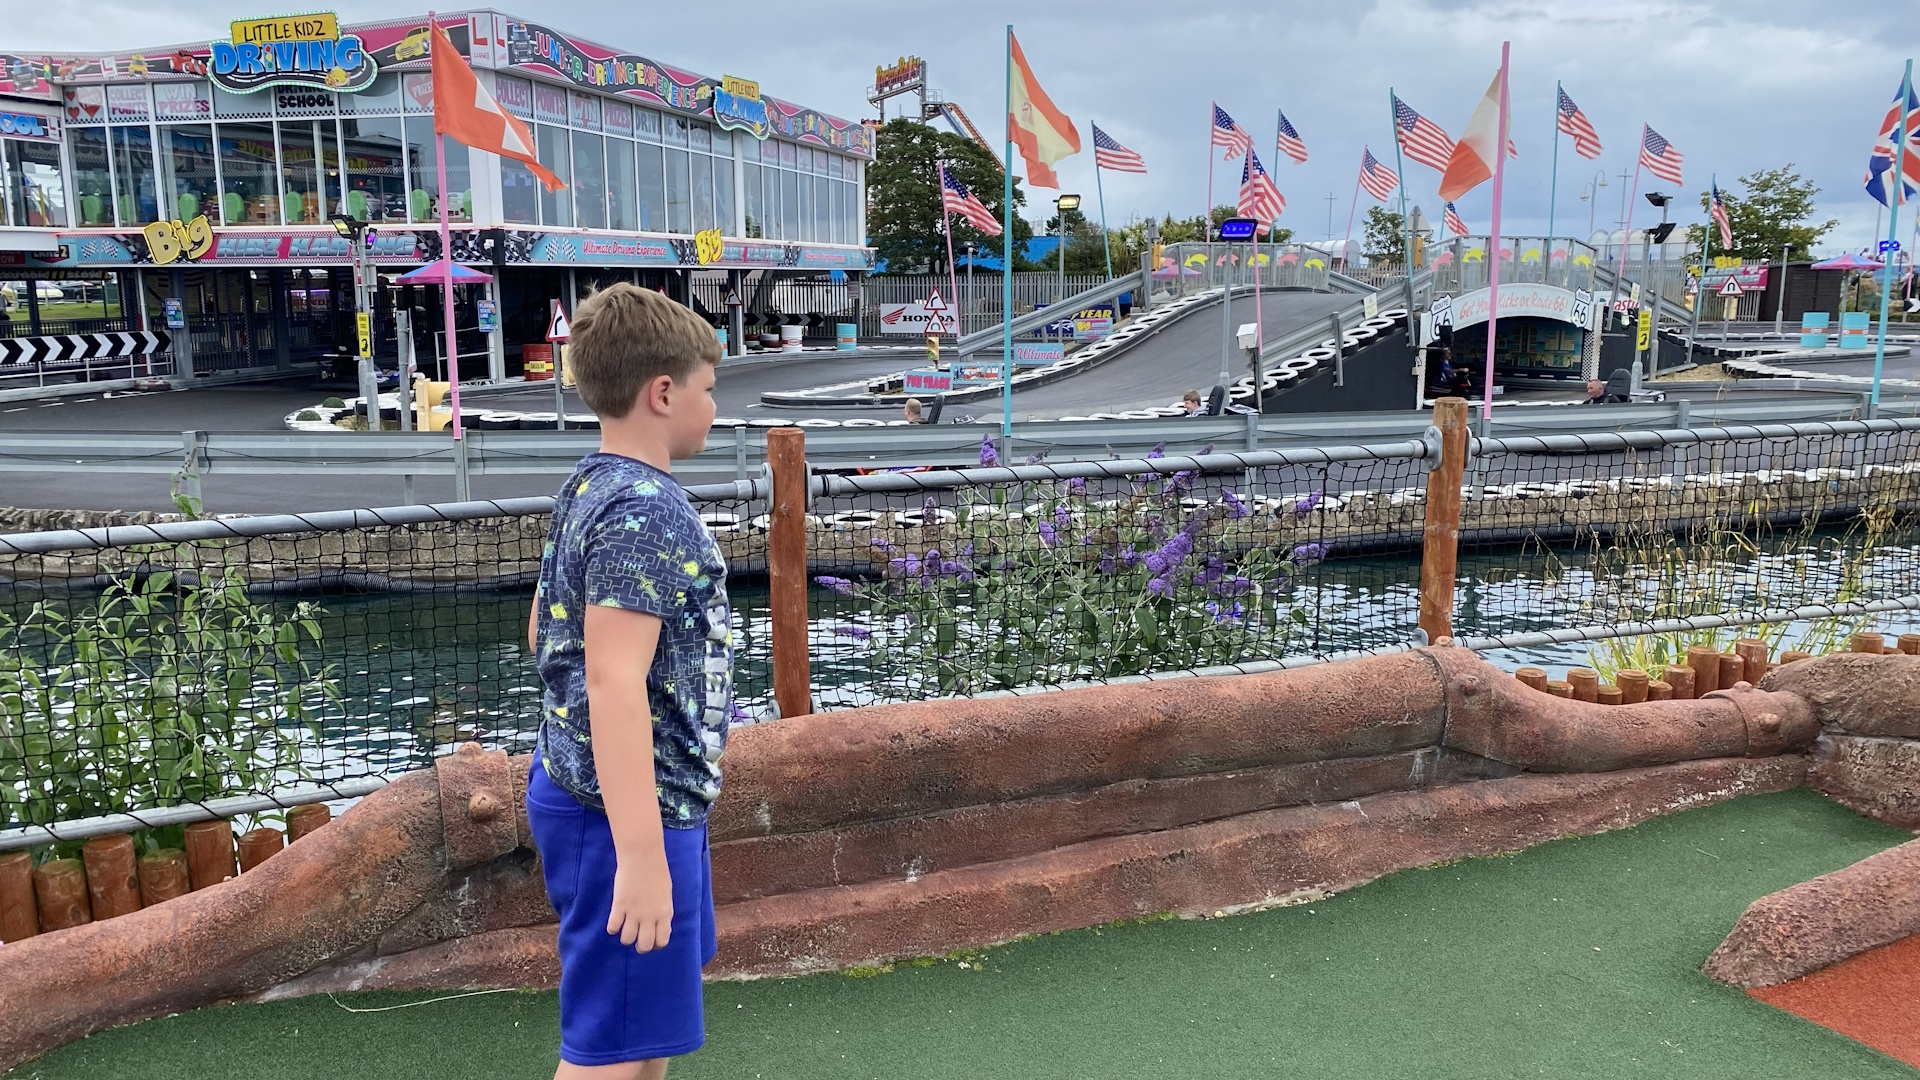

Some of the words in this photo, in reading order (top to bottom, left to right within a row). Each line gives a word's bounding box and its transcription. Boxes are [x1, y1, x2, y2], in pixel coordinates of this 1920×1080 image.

[243, 23, 290, 43] LITTLE
[294, 20, 326, 37] KIDZ
[472, 17, 488, 47] L
[212, 38, 362, 75] DRIVING
[534, 31, 583, 81] JUNIOR
[588, 57, 634, 86] DRIVING
[637, 63, 698, 110] EXPERIENCE
[162, 84, 198, 101] WIN
[412, 81, 434, 98] PRIZE
[496, 78, 529, 109] COLLECT
[158, 100, 211, 114] PRIZES
[278, 94, 334, 108] SCHOOL
[535, 86, 566, 116] POINTS
[572, 99, 598, 122] WIN
[604, 102, 631, 129] PRIZES
[143, 215, 214, 265] Big
[216, 237, 282, 258] KIDZ
[288, 235, 417, 258] KARNG
[583, 240, 611, 255] Ultimate
[612, 240, 635, 258] Driving
[636, 242, 666, 258] Experience
[695, 228, 725, 266] Big
[1714, 255, 1743, 269] Big
[1433, 299, 1449, 311] ROUTE
[1574, 304, 1586, 325] 66
[1017, 346, 1061, 360] Ultimate
[906, 374, 923, 389] FUN
[923, 375, 951, 390] TRACK
[623, 560, 644, 571] TNT
[690, 657, 704, 667] TNT
